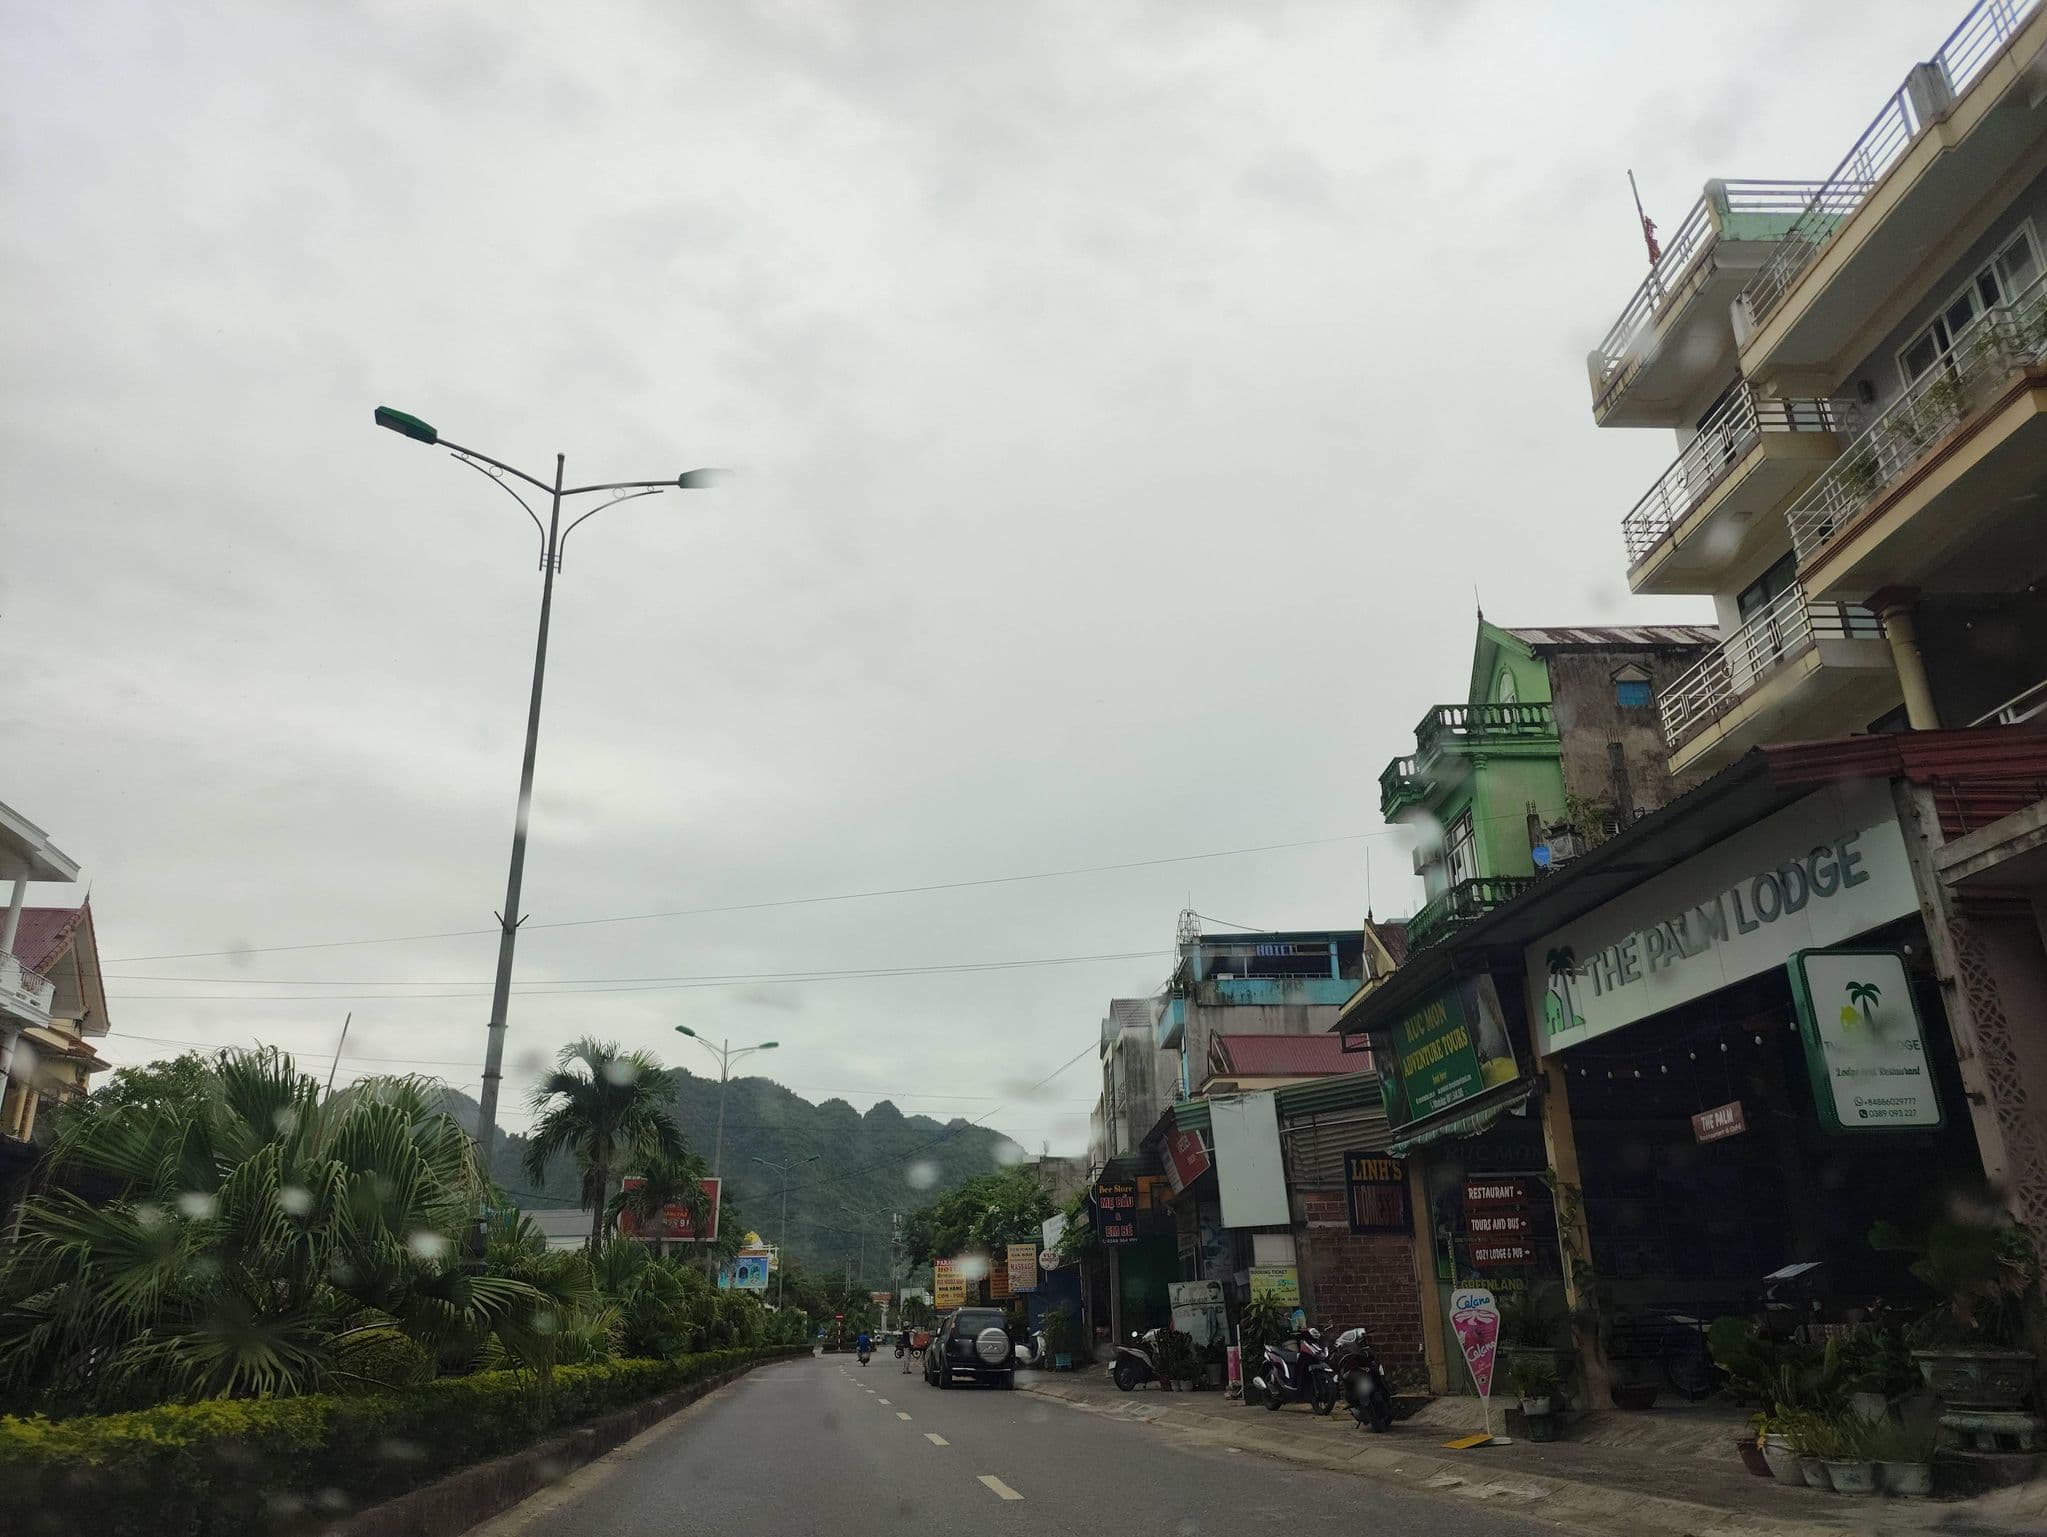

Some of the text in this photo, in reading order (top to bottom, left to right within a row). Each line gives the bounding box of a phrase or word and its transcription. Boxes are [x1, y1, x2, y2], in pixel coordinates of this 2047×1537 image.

[1584, 829, 1871, 997] THE PALM LODGE
[1255, 944, 1295, 956] HOTEL
[1403, 1025, 1469, 1078] ADVENTURE TOURS
[1714, 1107, 1734, 1127] PALM
[1350, 1159, 1402, 1181] LINH'S
[1467, 1186, 1514, 1200] RESTAURANT
[1471, 1218, 1520, 1231] TOURS AND BUS
[1476, 1249, 1489, 1261] COZY
[1489, 1248, 1507, 1260] LODGE
[1512, 1247, 1524, 1259] PUB
[1460, 1278, 1524, 1291] GREENLAND
[1456, 1294, 1490, 1310] Celano
[1466, 1340, 1497, 1362] Celano
